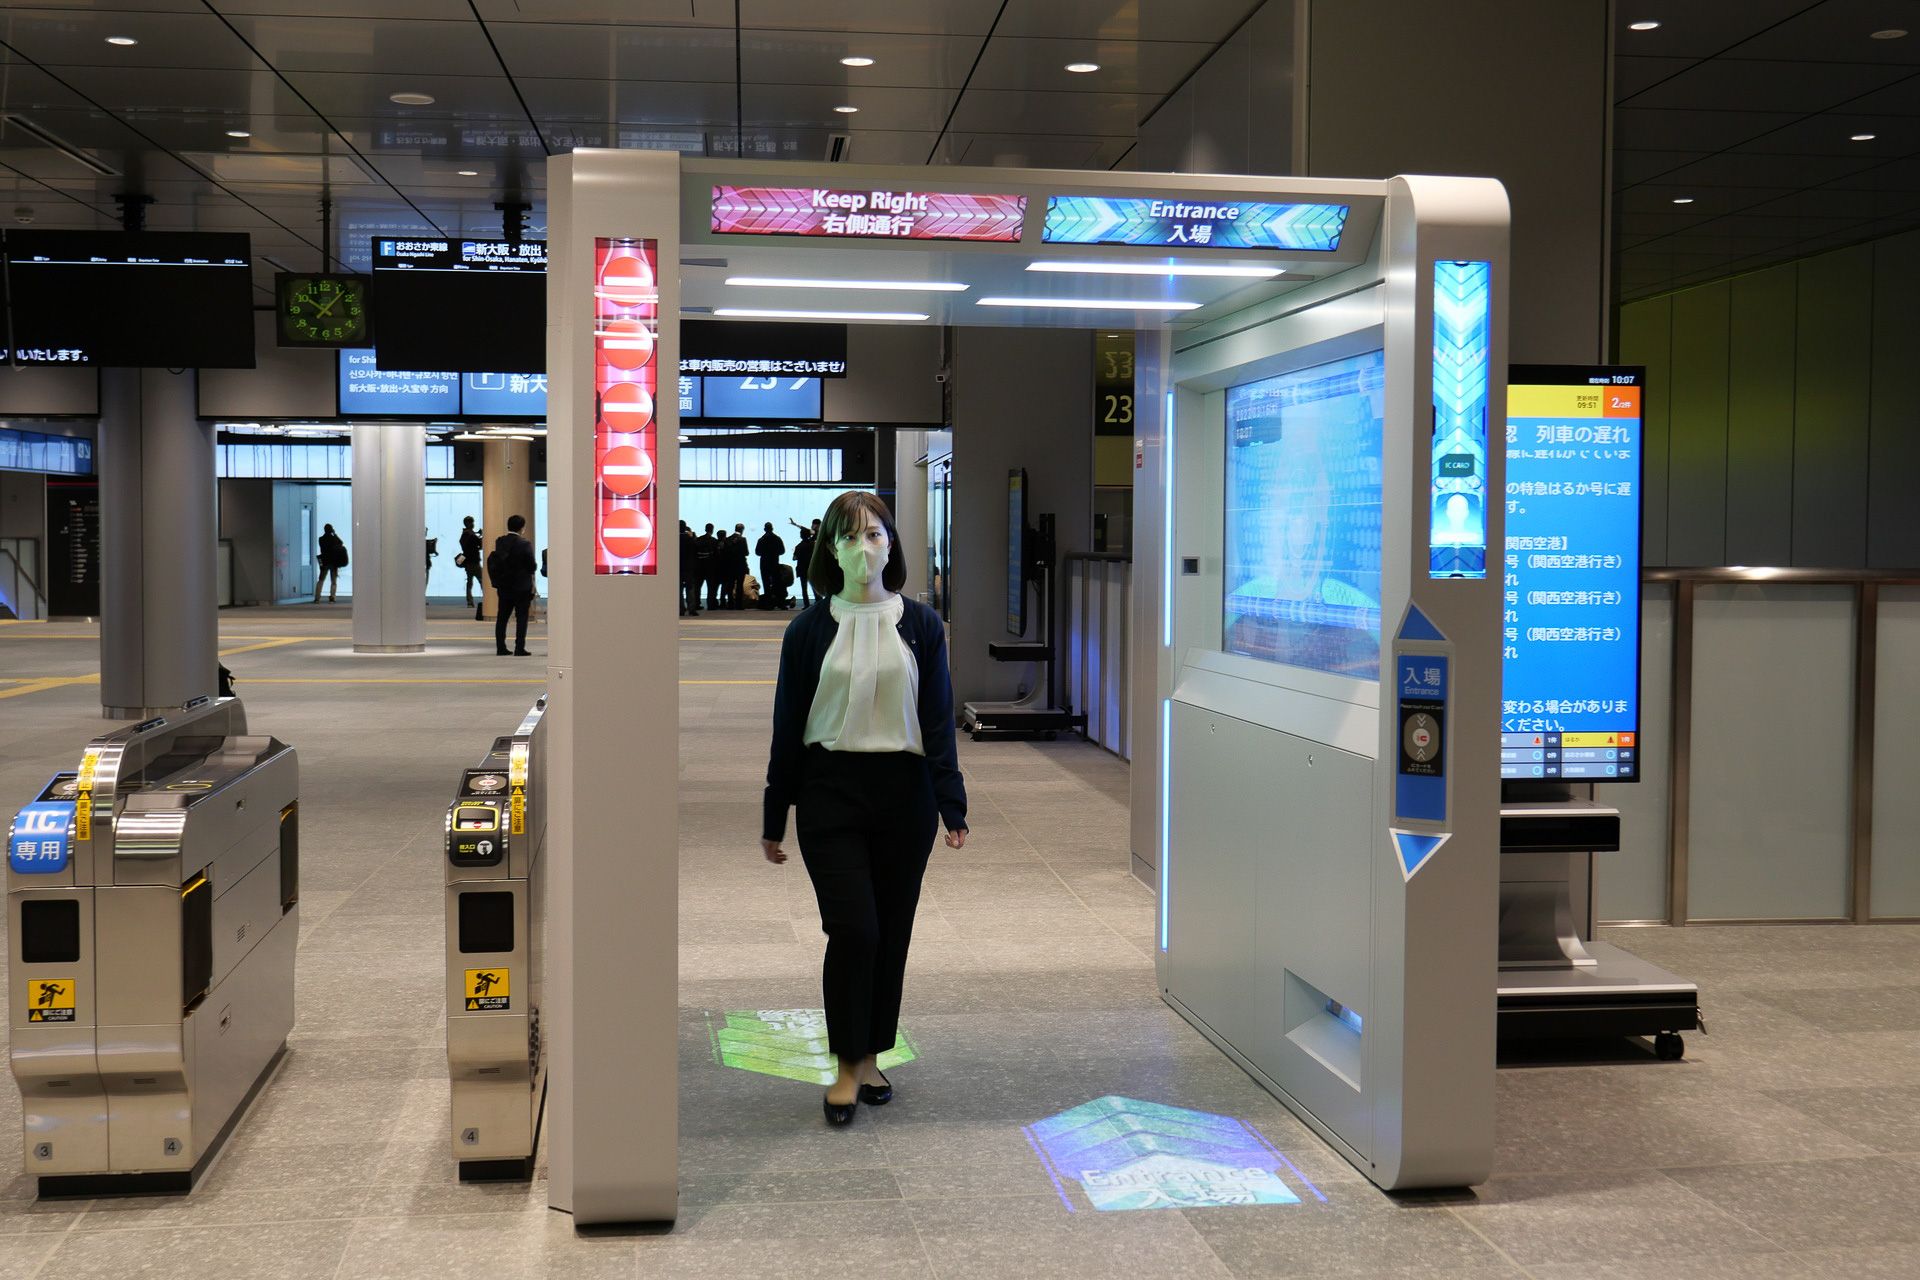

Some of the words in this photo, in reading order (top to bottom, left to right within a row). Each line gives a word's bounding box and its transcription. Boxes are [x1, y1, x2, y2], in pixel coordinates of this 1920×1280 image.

[812, 190, 866, 212] Keep
[870, 192, 928, 213] Right
[1150, 201, 1239, 220] Entrance
[822, 214, 914, 236] 右側通行
[1167, 225, 1212, 244] 入場
[384, 242, 392, 255] F
[396, 242, 448, 252] おおさか東線
[336, 286, 339, 294] 1
[292, 306, 300, 314] 9
[351, 307, 358, 315] 3
[300, 319, 307, 327] 8
[349, 356, 360, 364] for
[1612, 376, 1635, 384] 10:07
[430, 385, 448, 394] 方向
[679, 397, 692, 410] 面
[1104, 395, 1132, 423] 23
[1536, 425, 1630, 444] 列車の遅れ
[1506, 482, 1631, 496] の特急はるか号に遅
[1506, 501, 1526, 514] す。
[1506, 536, 1568, 550] 関西空港】
[1505, 574, 1519, 586] れ
[1505, 610, 1518, 622] れ
[1504, 646, 1518, 659] れ
[1404, 668, 1441, 686] 入場
[1404, 686, 1439, 695] Entrance
[1503, 700, 1628, 714] 変わる場合がありま
[25, 810, 59, 831] IC
[16, 841, 60, 860] 専用
[468, 1132, 474, 1142] 4
[40, 1146, 49, 1157] 3
[168, 1142, 175, 1152] 4
[1081, 1167, 1268, 1186] Entrance
[1137, 1184, 1260, 1208] 入場
